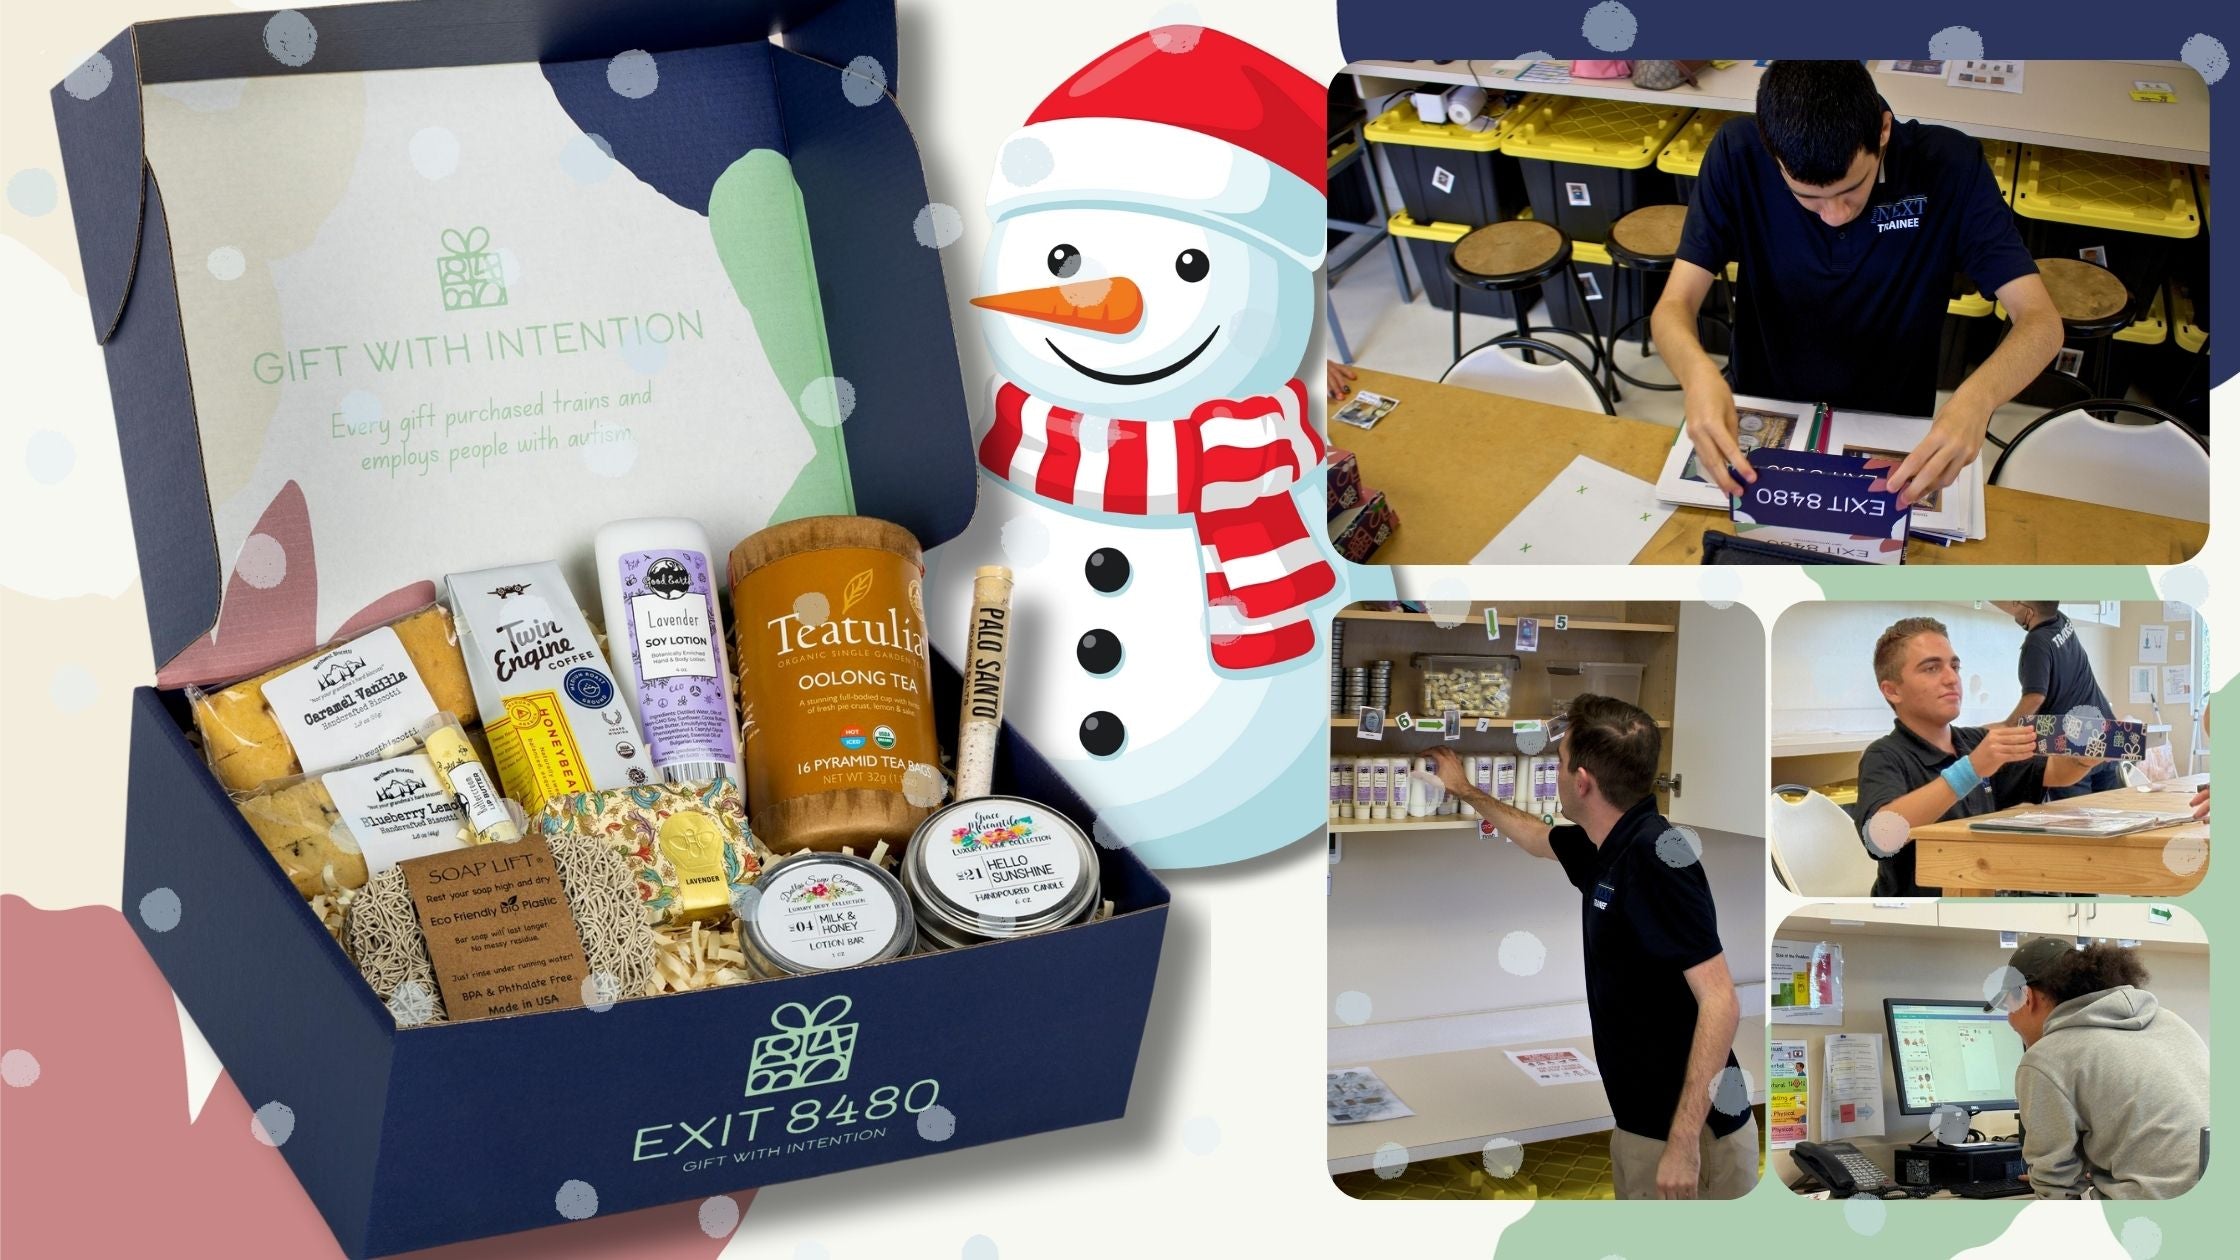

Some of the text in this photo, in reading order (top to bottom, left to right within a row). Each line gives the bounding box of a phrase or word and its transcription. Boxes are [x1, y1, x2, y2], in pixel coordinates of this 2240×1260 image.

[1877, 218, 1919, 233] TRAINEE
[253, 309, 704, 385] GIFT WITH INTENTION
[332, 380, 653, 446] Every gift purchased trains and
[361, 439, 440, 479] employs
[449, 438, 509, 473] people
[517, 424, 559, 454] with
[1756, 487, 1886, 517] EXIT 8480
[647, 608, 699, 629] Lavender
[1557, 616, 1567, 630] 5
[496, 619, 563, 654] Twin
[646, 636, 708, 648] SOY LOTION
[767, 607, 926, 657] Teatulia
[494, 638, 575, 682] Engine
[548, 651, 595, 671] COFFEE
[778, 649, 911, 669] ORGANIC SINGLE GARDEN
[972, 607, 1005, 720] PALO SANTO
[585, 672, 606, 685] ROAST
[799, 669, 919, 695] OOLONG TEA
[964, 669, 973, 707] SALTS
[303, 694, 358, 726] Caramel
[355, 671, 409, 701] Vanilla
[321, 703, 369, 731] Handcrafted
[368, 687, 402, 708] Biscotti
[582, 694, 607, 705] GROUND
[807, 696, 838, 706] stunning
[839, 693, 880, 701] full-bodied
[880, 695, 893, 703] cup
[807, 706, 816, 714] of
[816, 703, 836, 712] fresh
[837, 702, 850, 711] pie
[873, 703, 895, 712] lemon
[1399, 714, 1410, 728] 6
[1480, 721, 1487, 729] 7
[540, 747, 554, 778] Naturally
[798, 755, 932, 779] 16 PYRAMID TEA BAGS
[473, 772, 490, 799] BUTTER
[823, 771, 887, 785] NET WT 32g
[487, 799, 496, 810] LIP
[360, 806, 426, 829] Blueberry
[379, 813, 460, 835] Handcrafted Biscotti
[966, 814, 1020, 834] Mercantile
[974, 810, 999, 824] Grace
[1543, 814, 1554, 827] 9
[429, 853, 534, 884] SOAP LIFT
[986, 855, 1029, 871] HELLO
[991, 864, 1056, 883] SUNSHINE
[426, 875, 551, 903] Rest your soap high and dry
[685, 874, 720, 886] LAVENDER
[430, 896, 558, 927] Eco Friendly bio Plastic
[819, 911, 857, 925] MILK &
[454, 936, 469, 945] Bar
[471, 933, 489, 941] soap
[491, 927, 505, 937] will
[507, 926, 521, 934] last
[822, 921, 860, 935] HONEY
[471, 945, 482, 953] No
[484, 941, 508, 950] messy
[809, 936, 865, 951] LOTION BAR
[451, 953, 574, 982] Just rinse under running water!
[462, 990, 483, 1001] BPA
[486, 988, 495, 997] &
[498, 978, 547, 994] Phthalate
[488, 994, 560, 1015] Made in USA
[632, 1078, 940, 1162] EXIT 8480
[682, 1127, 887, 1173] GIFT WITH INTENTION
